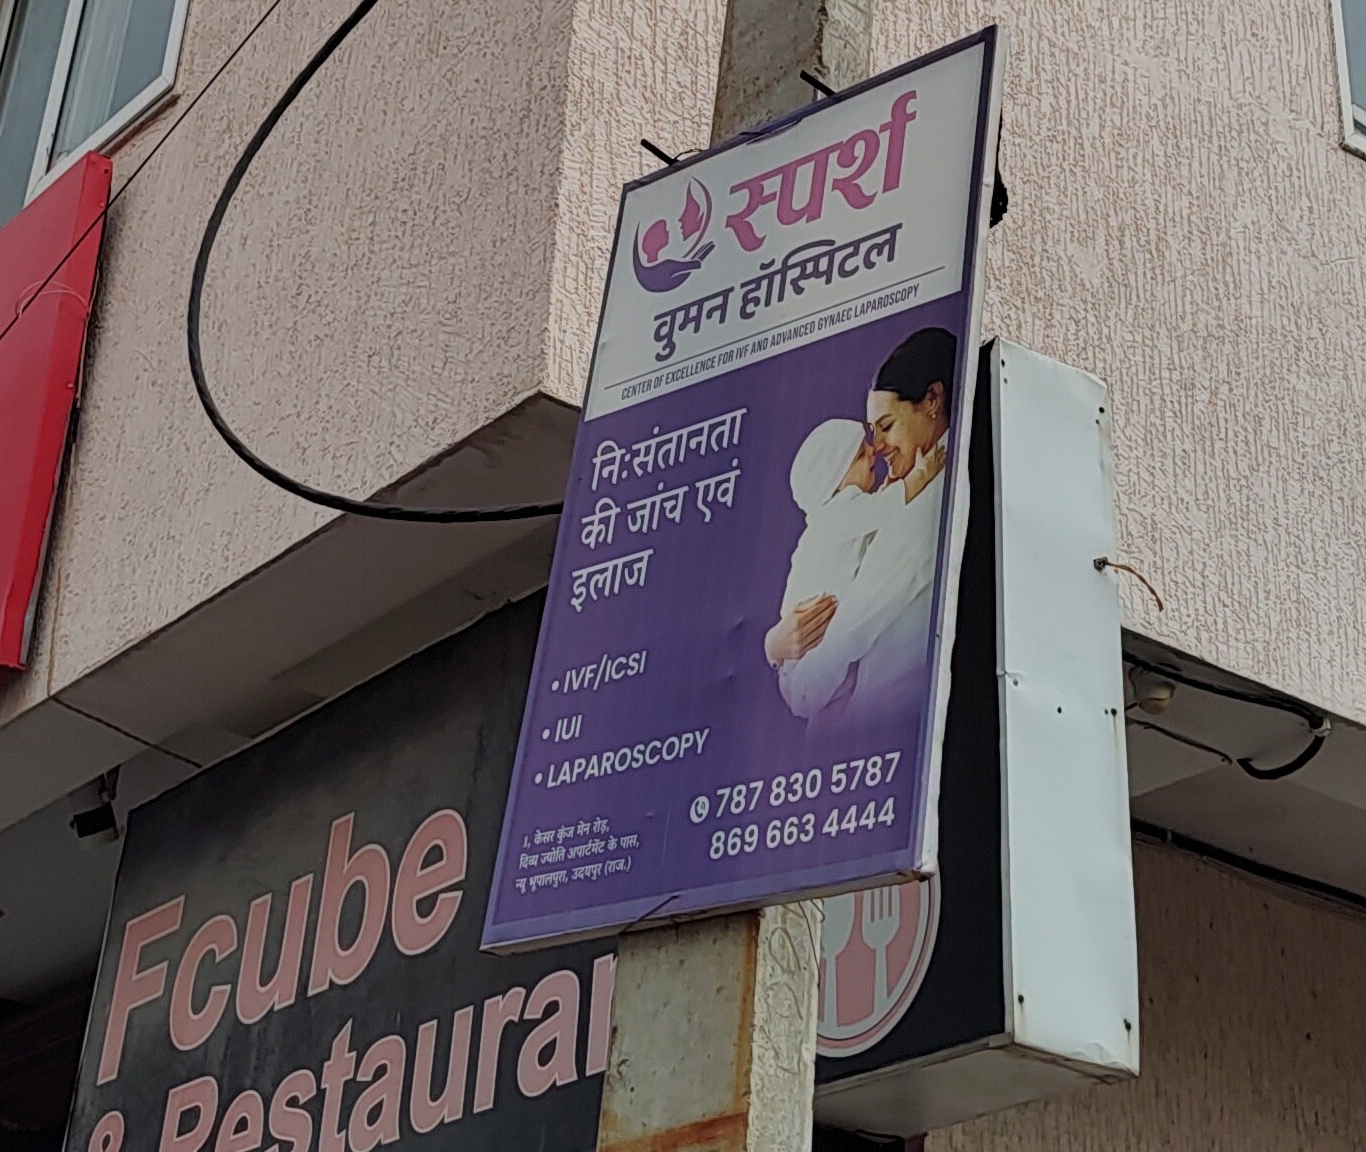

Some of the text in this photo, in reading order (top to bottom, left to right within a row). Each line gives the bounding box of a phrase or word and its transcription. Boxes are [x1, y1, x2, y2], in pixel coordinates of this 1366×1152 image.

[725, 90, 917, 252] स्पर्श
[654, 223, 903, 362] वुमन हॉस्पिटल
[621, 282, 921, 400] CENTER OF EXCELLENCE FOR IVF AND ADVANCED GYNAEC LAPAROSCOPY
[581, 458, 741, 550] की जांच एवं
[570, 549, 654, 613] इलाज
[563, 650, 647, 694] IVF/ICSI
[546, 727, 710, 789] LAPAROSCOPY
[554, 714, 583, 743] IUI
[715, 751, 901, 818] 787 830 5787
[607, 834, 617, 851] के
[709, 797, 895, 860] 869 663 4444
[96, 809, 468, 1087] Fcube
